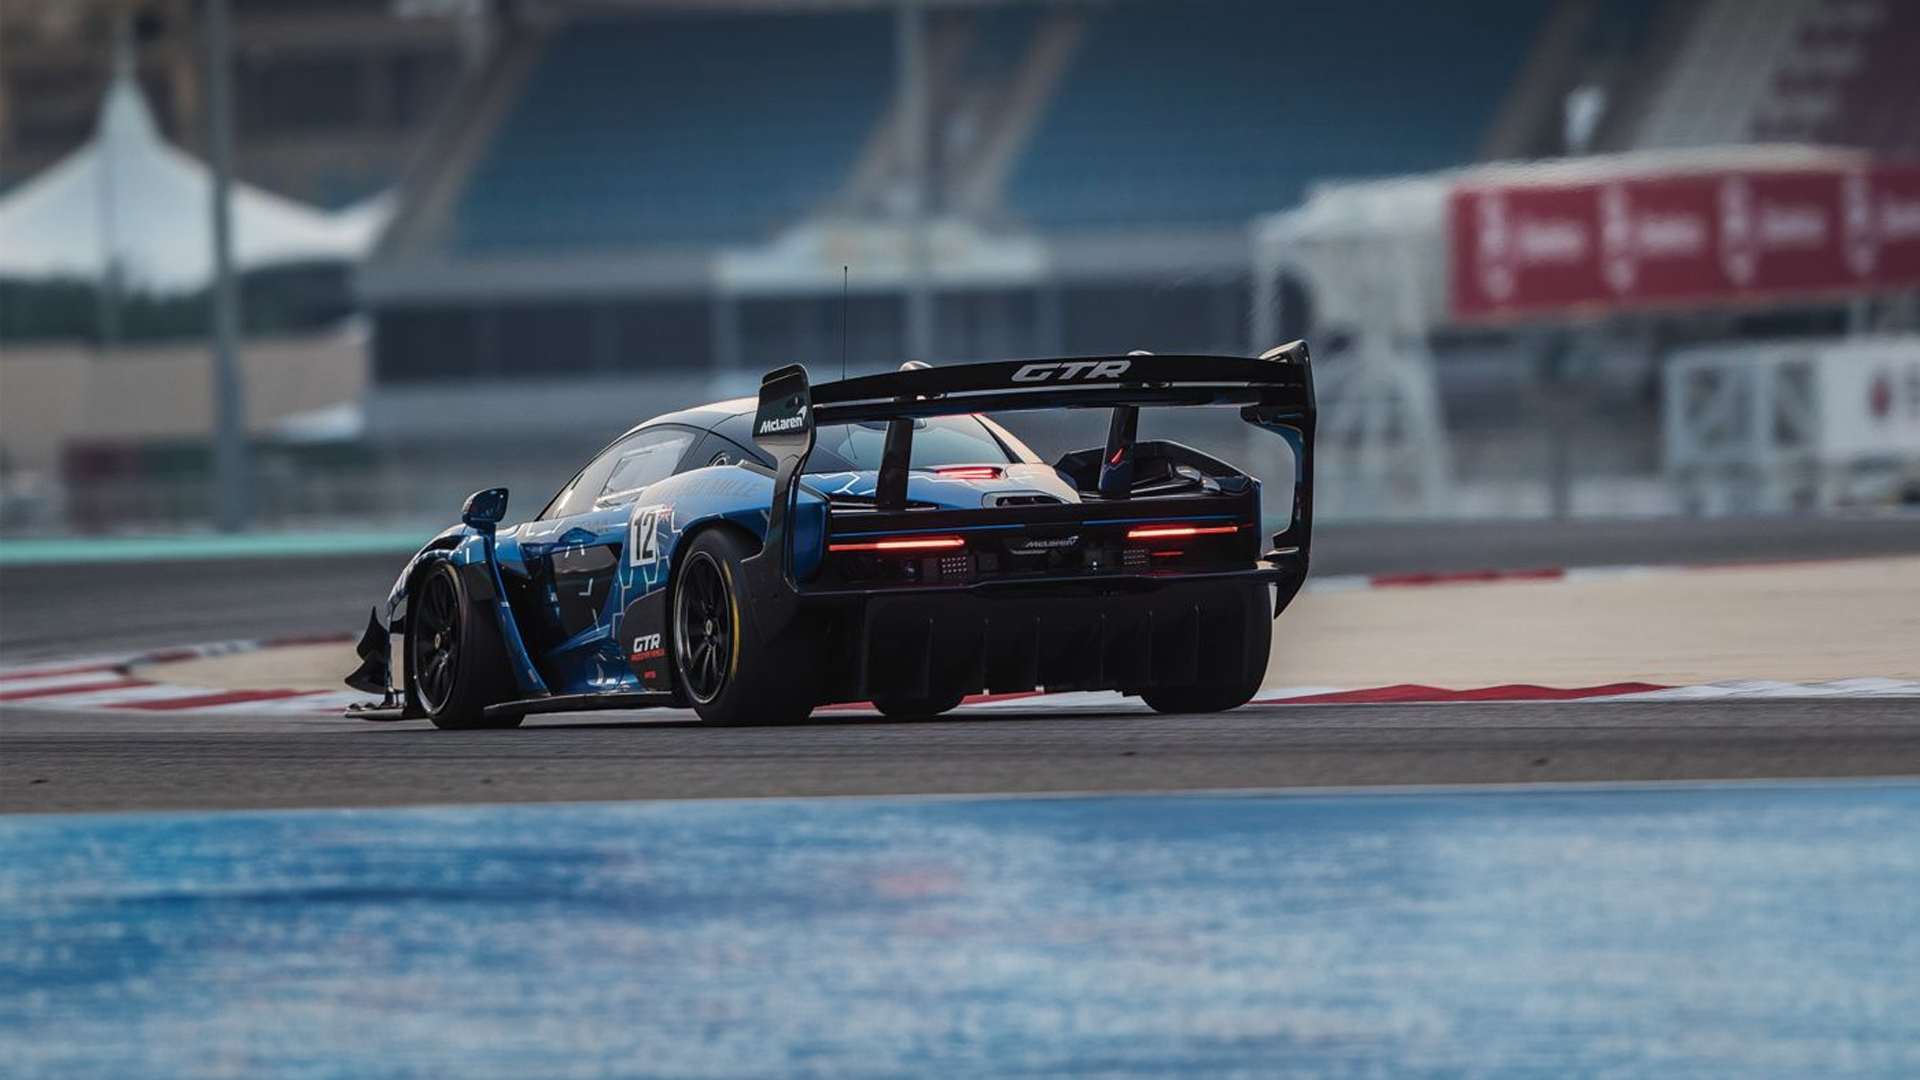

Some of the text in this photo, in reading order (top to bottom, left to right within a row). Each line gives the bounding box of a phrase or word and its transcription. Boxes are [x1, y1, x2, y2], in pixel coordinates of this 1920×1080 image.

[1011, 360, 1132, 382] GTR
[760, 416, 803, 434] McLaren
[633, 511, 657, 561] 12
[633, 633, 661, 653] GTR
